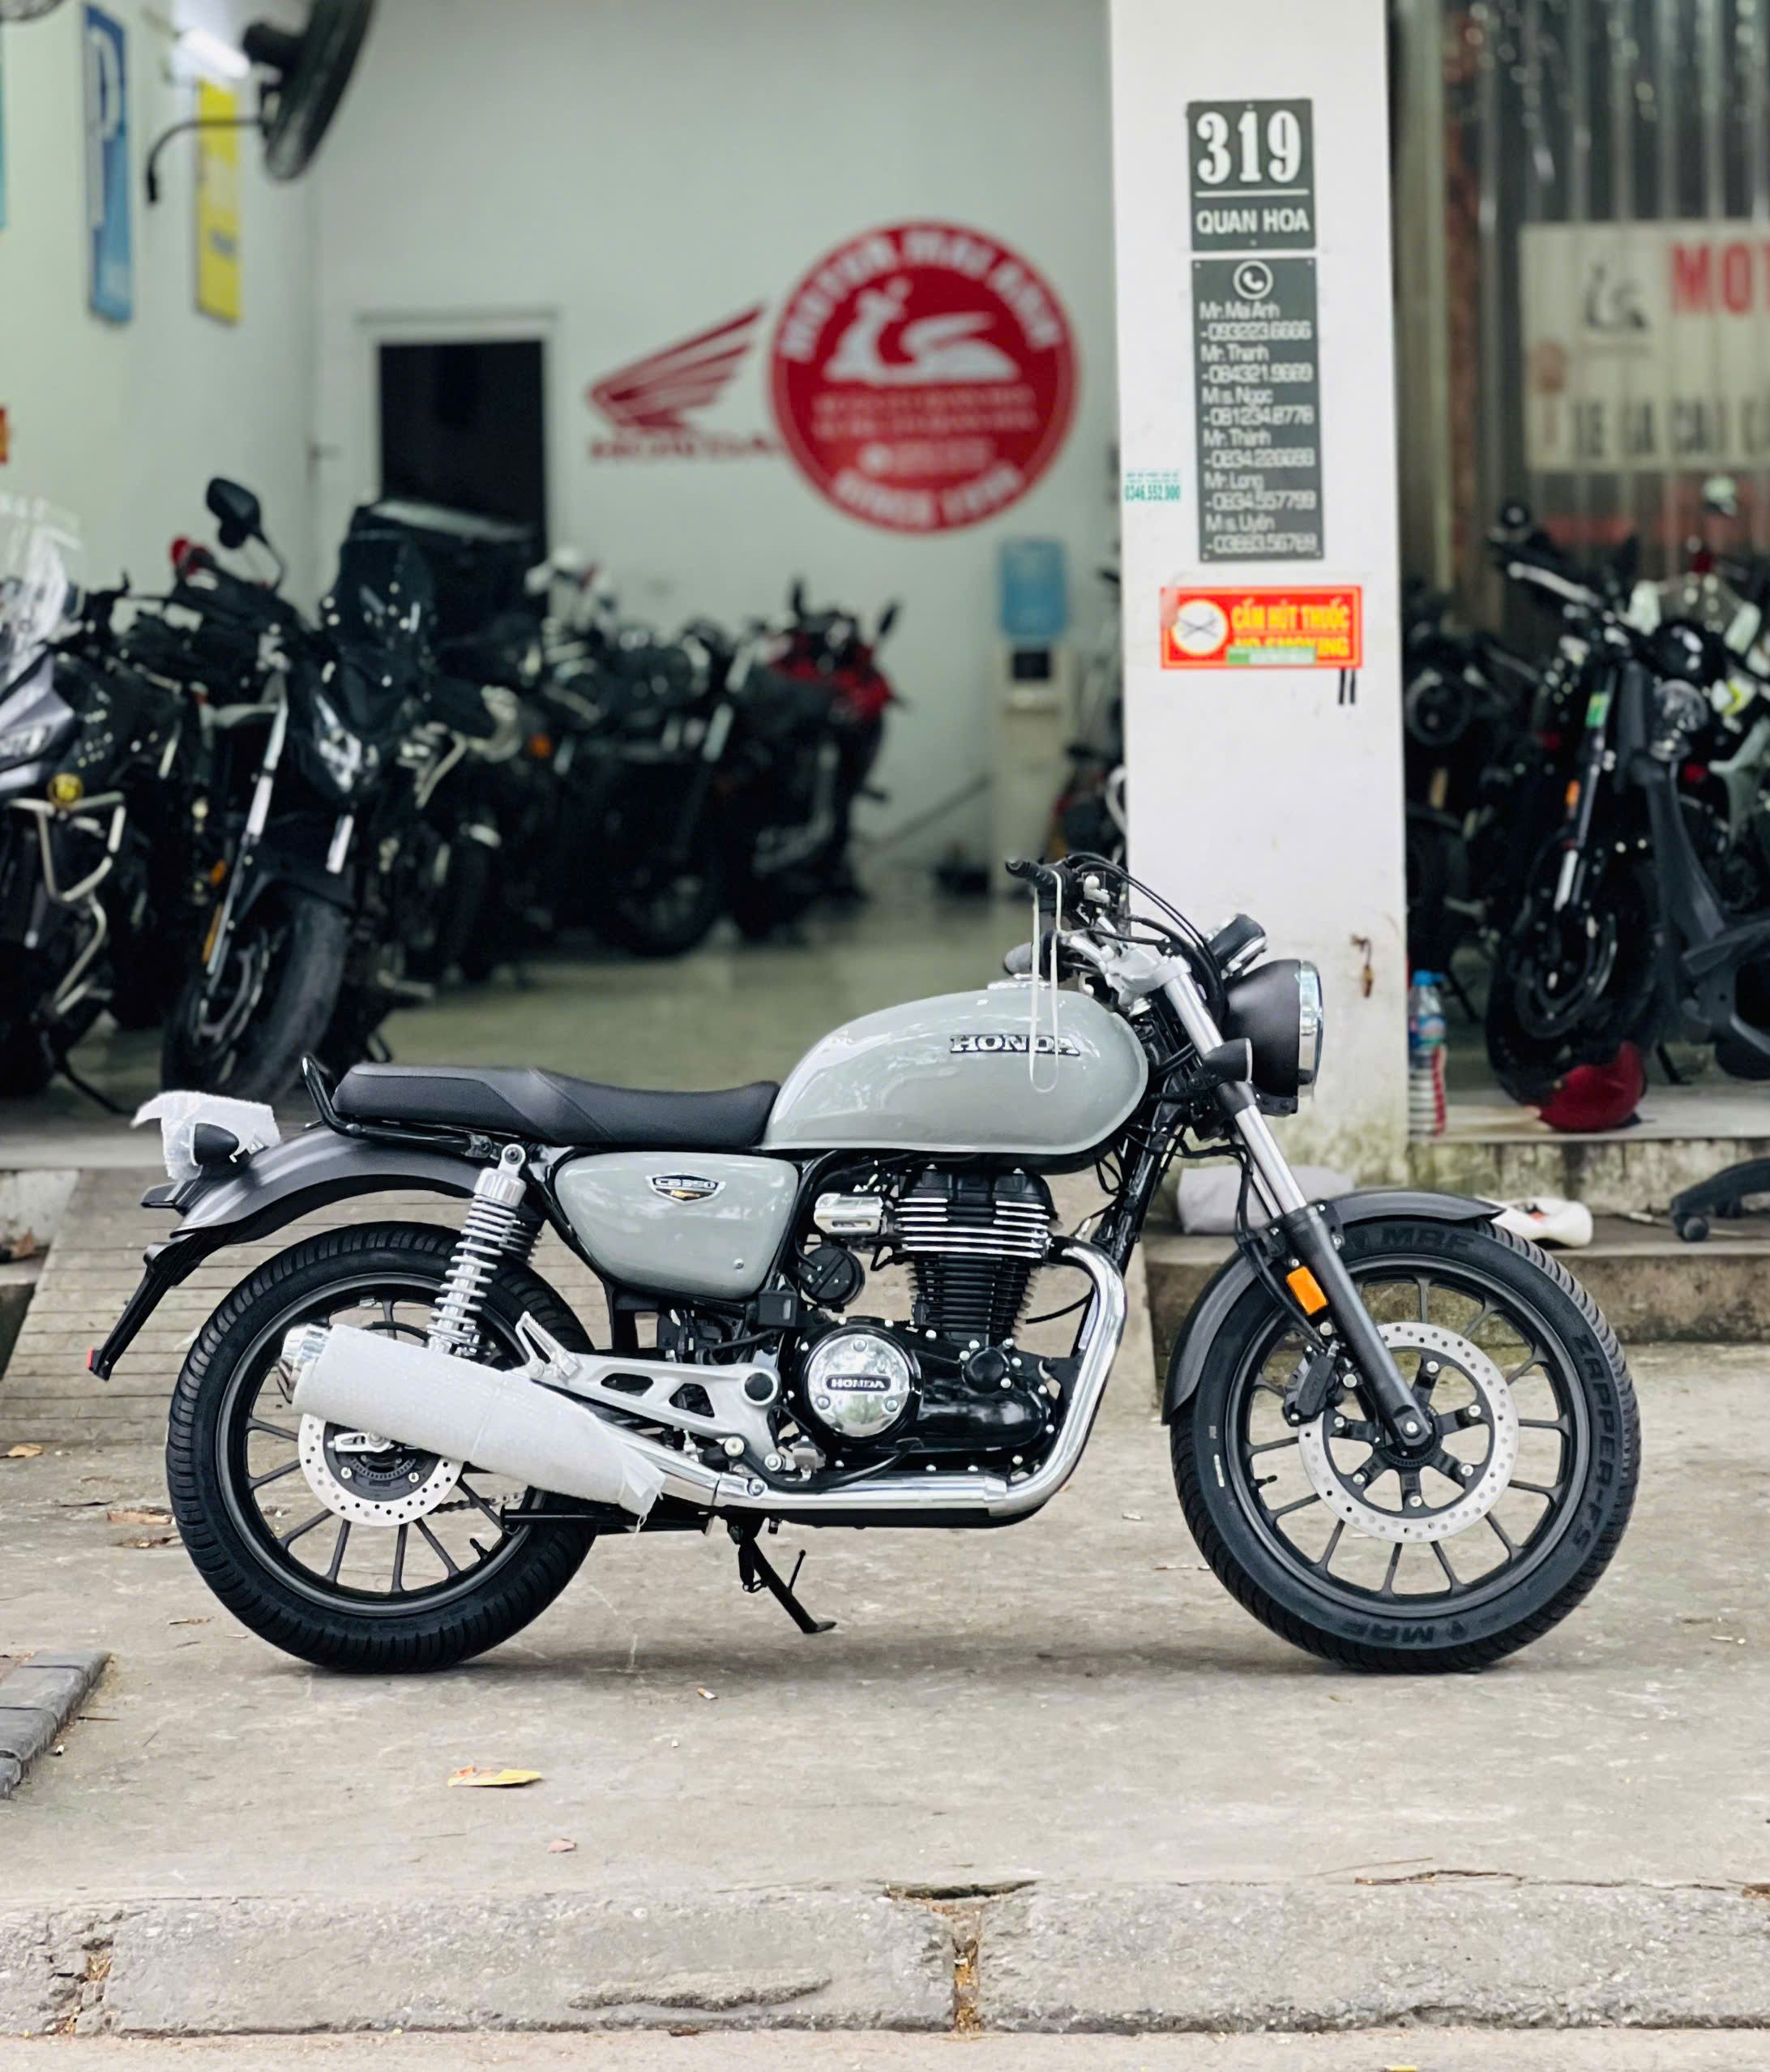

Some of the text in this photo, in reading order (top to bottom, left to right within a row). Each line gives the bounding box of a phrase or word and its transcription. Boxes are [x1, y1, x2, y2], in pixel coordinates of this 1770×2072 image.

[1196, 109, 1302, 184] 319
[1196, 208, 1310, 234] QUAN HOA
[1670, 241, 1770, 315] MO
[951, 1034, 1080, 1055] HONDA
[655, 1178, 716, 1189] CB350
[831, 1378, 886, 1389] HONDA
